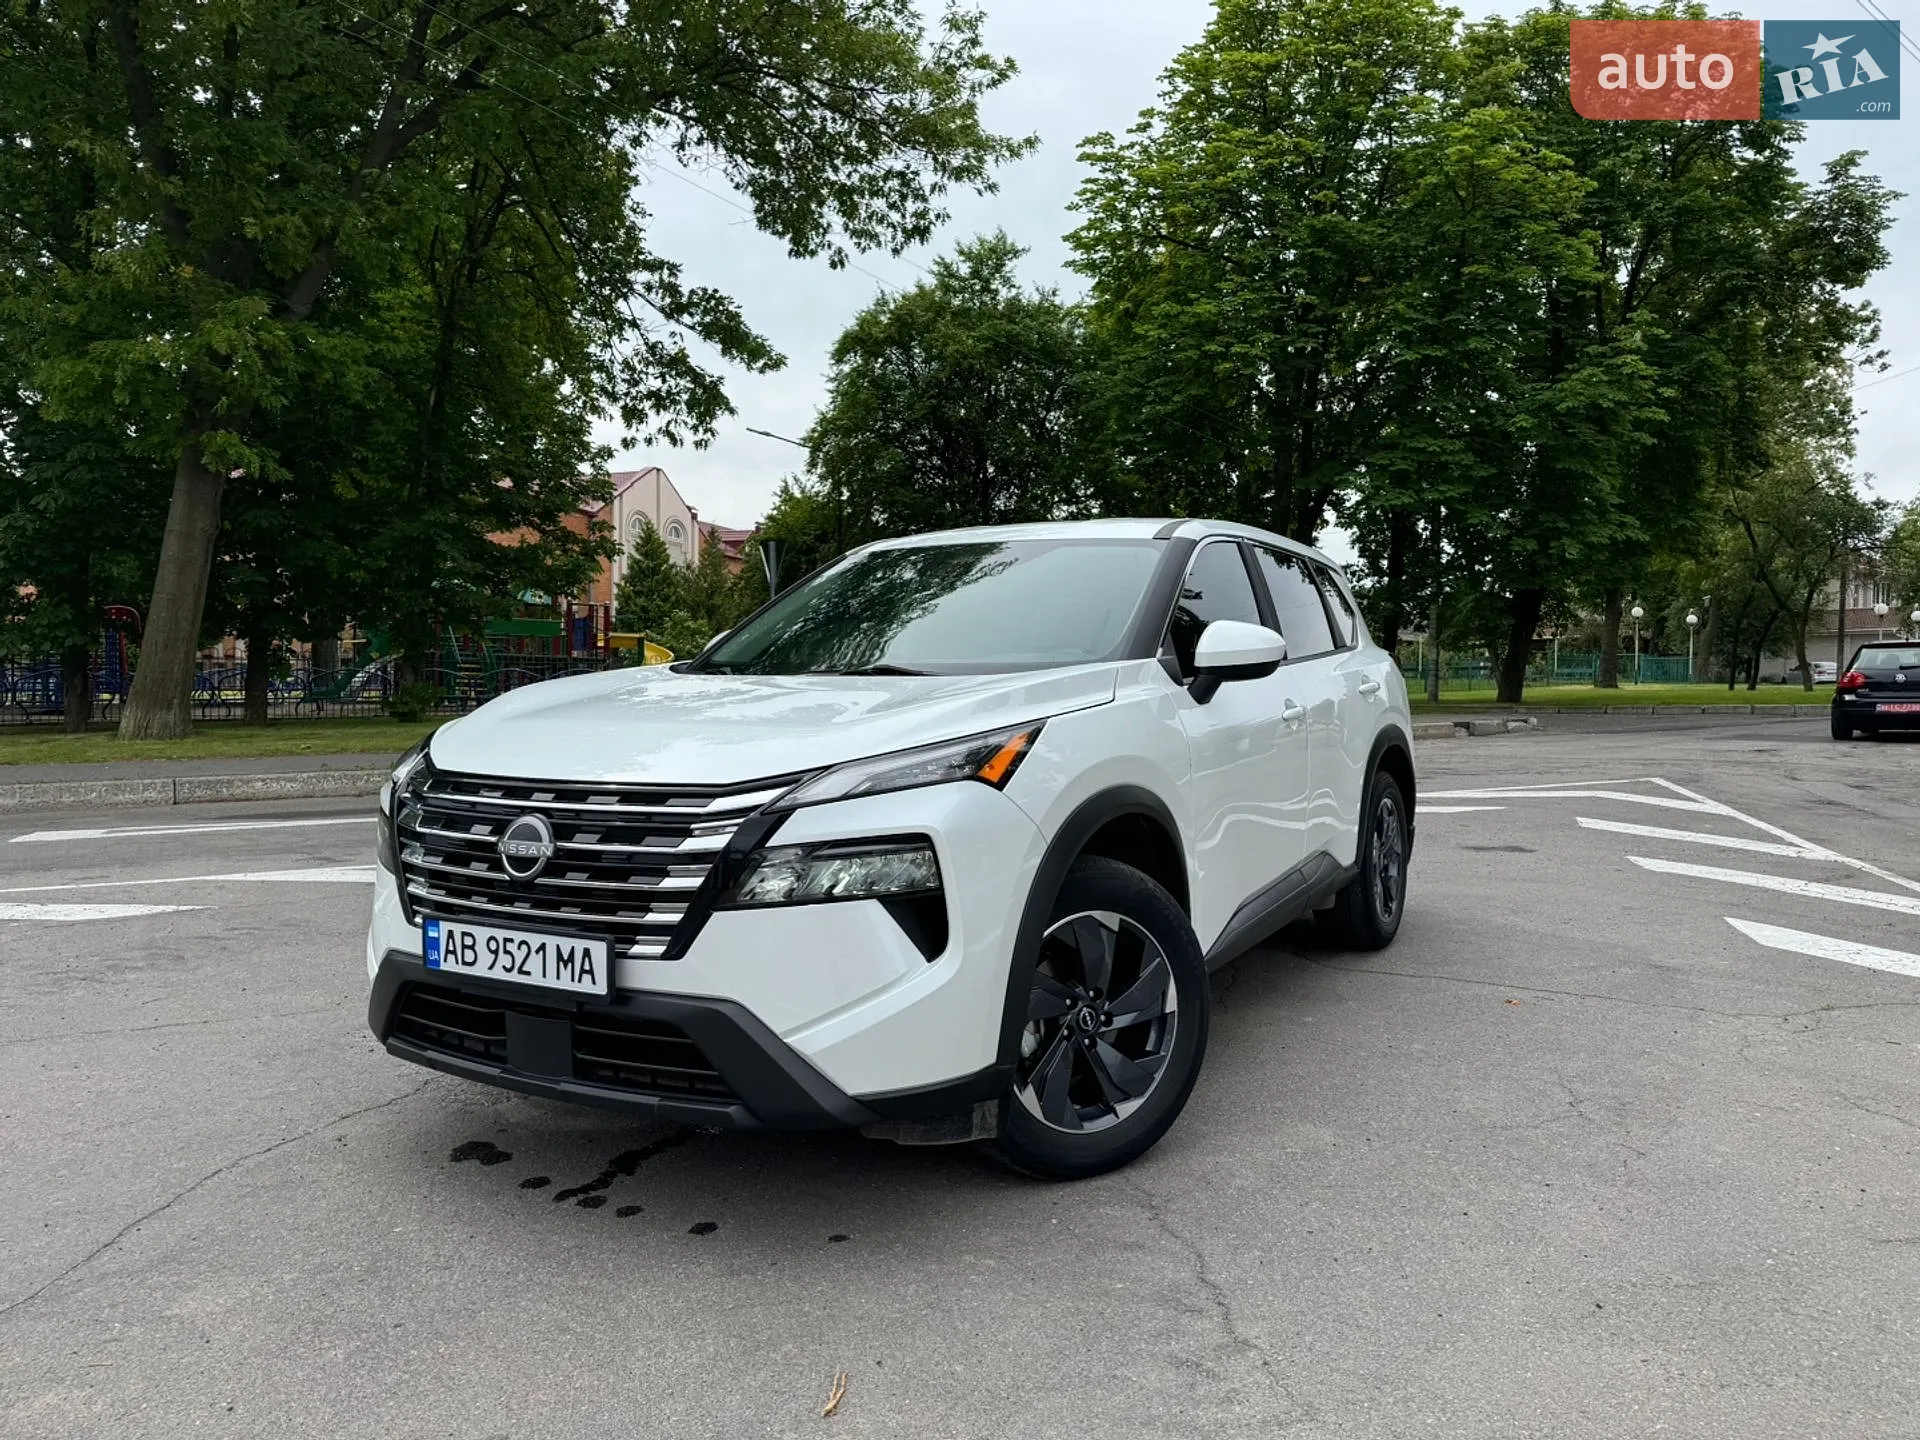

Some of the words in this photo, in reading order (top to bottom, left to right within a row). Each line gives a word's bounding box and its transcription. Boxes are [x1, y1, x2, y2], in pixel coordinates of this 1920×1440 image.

[498, 841, 552, 857] NISSAN
[428, 949, 440, 961] UA
[443, 929, 478, 967] AB
[486, 935, 547, 979] 9521
[556, 943, 597, 986] MA
